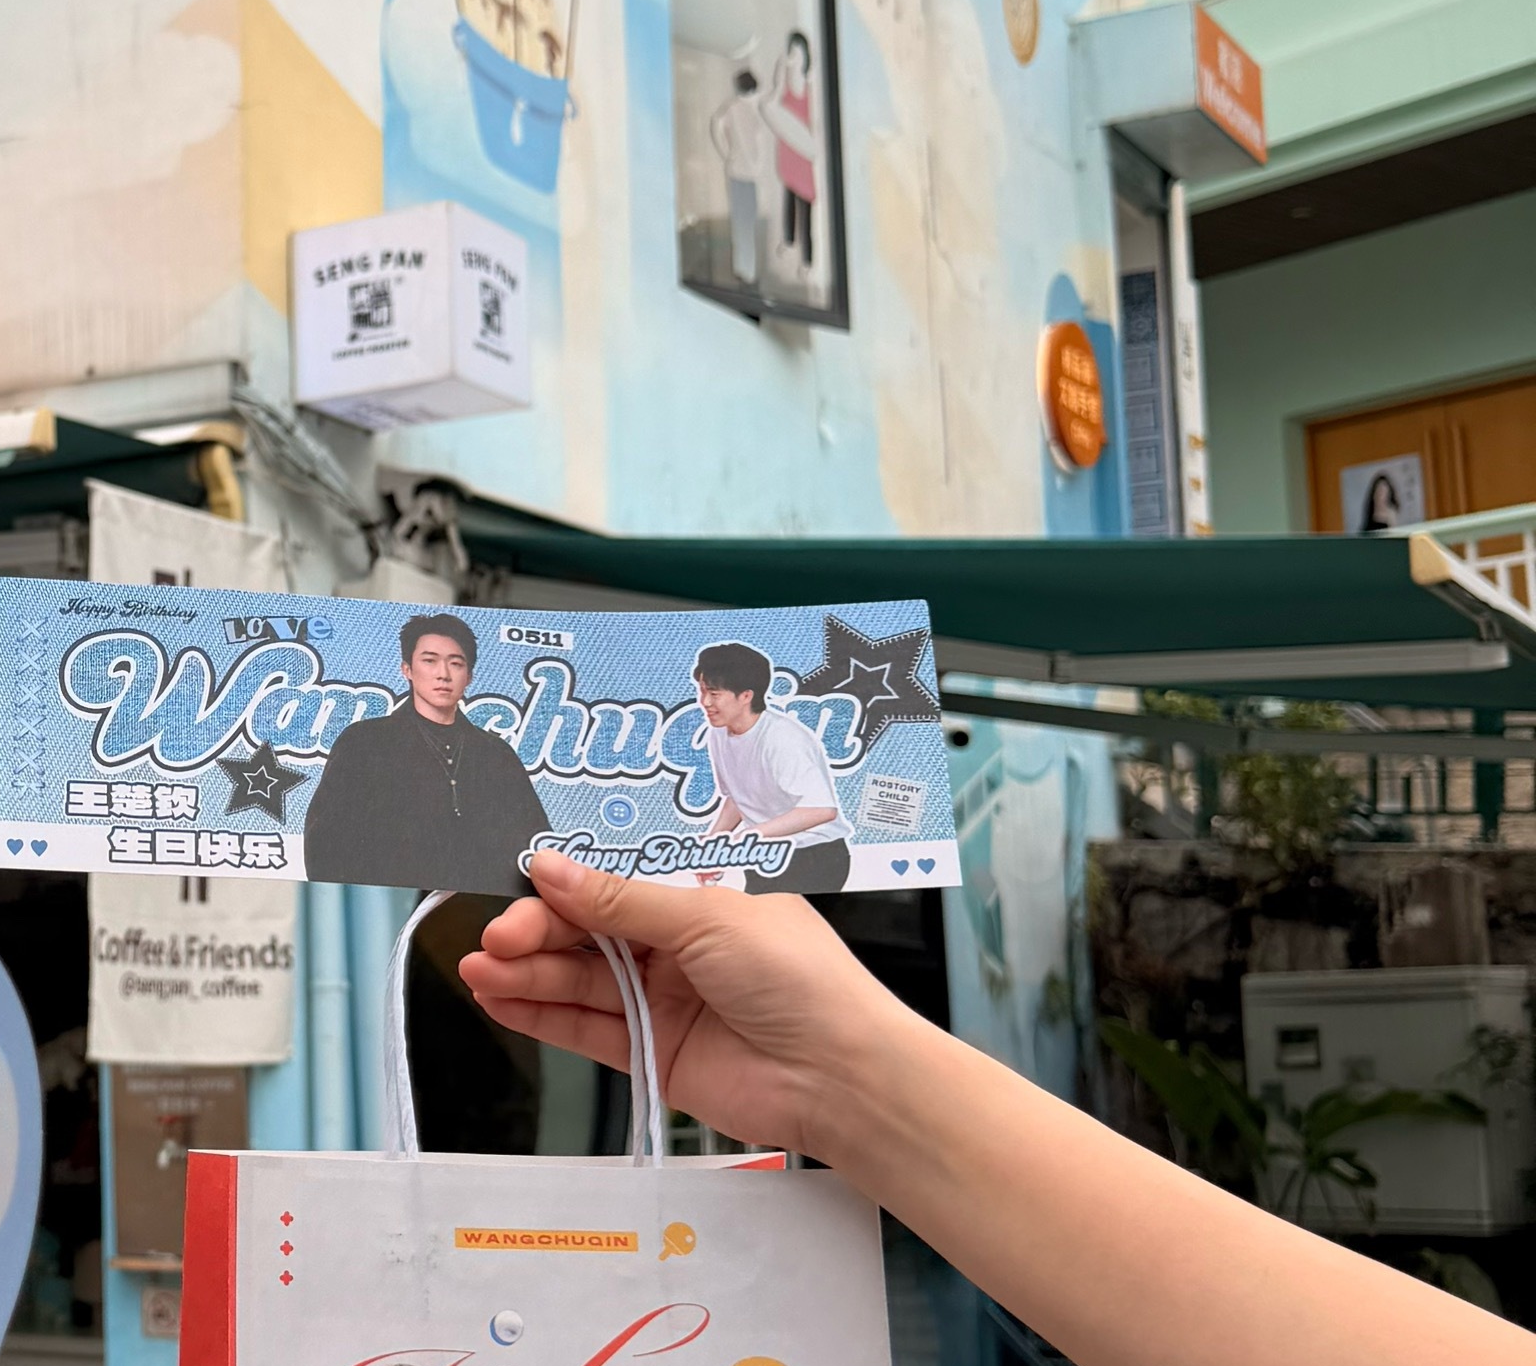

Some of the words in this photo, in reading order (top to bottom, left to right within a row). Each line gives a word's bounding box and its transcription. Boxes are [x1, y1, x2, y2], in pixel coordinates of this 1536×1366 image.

[313, 254, 372, 287] SENG
[380, 249, 427, 271] PAN
[60, 598, 115, 620] Happy
[119, 599, 199, 623] Birthday
[506, 627, 565, 648] 0511
[66, 779, 200, 822] 王楚钦
[878, 790, 910, 803] CHILD
[107, 825, 288, 869] 生日快乐
[639, 834, 790, 873] Birthday
[464, 1232, 629, 1248] WANGCHUQIN
